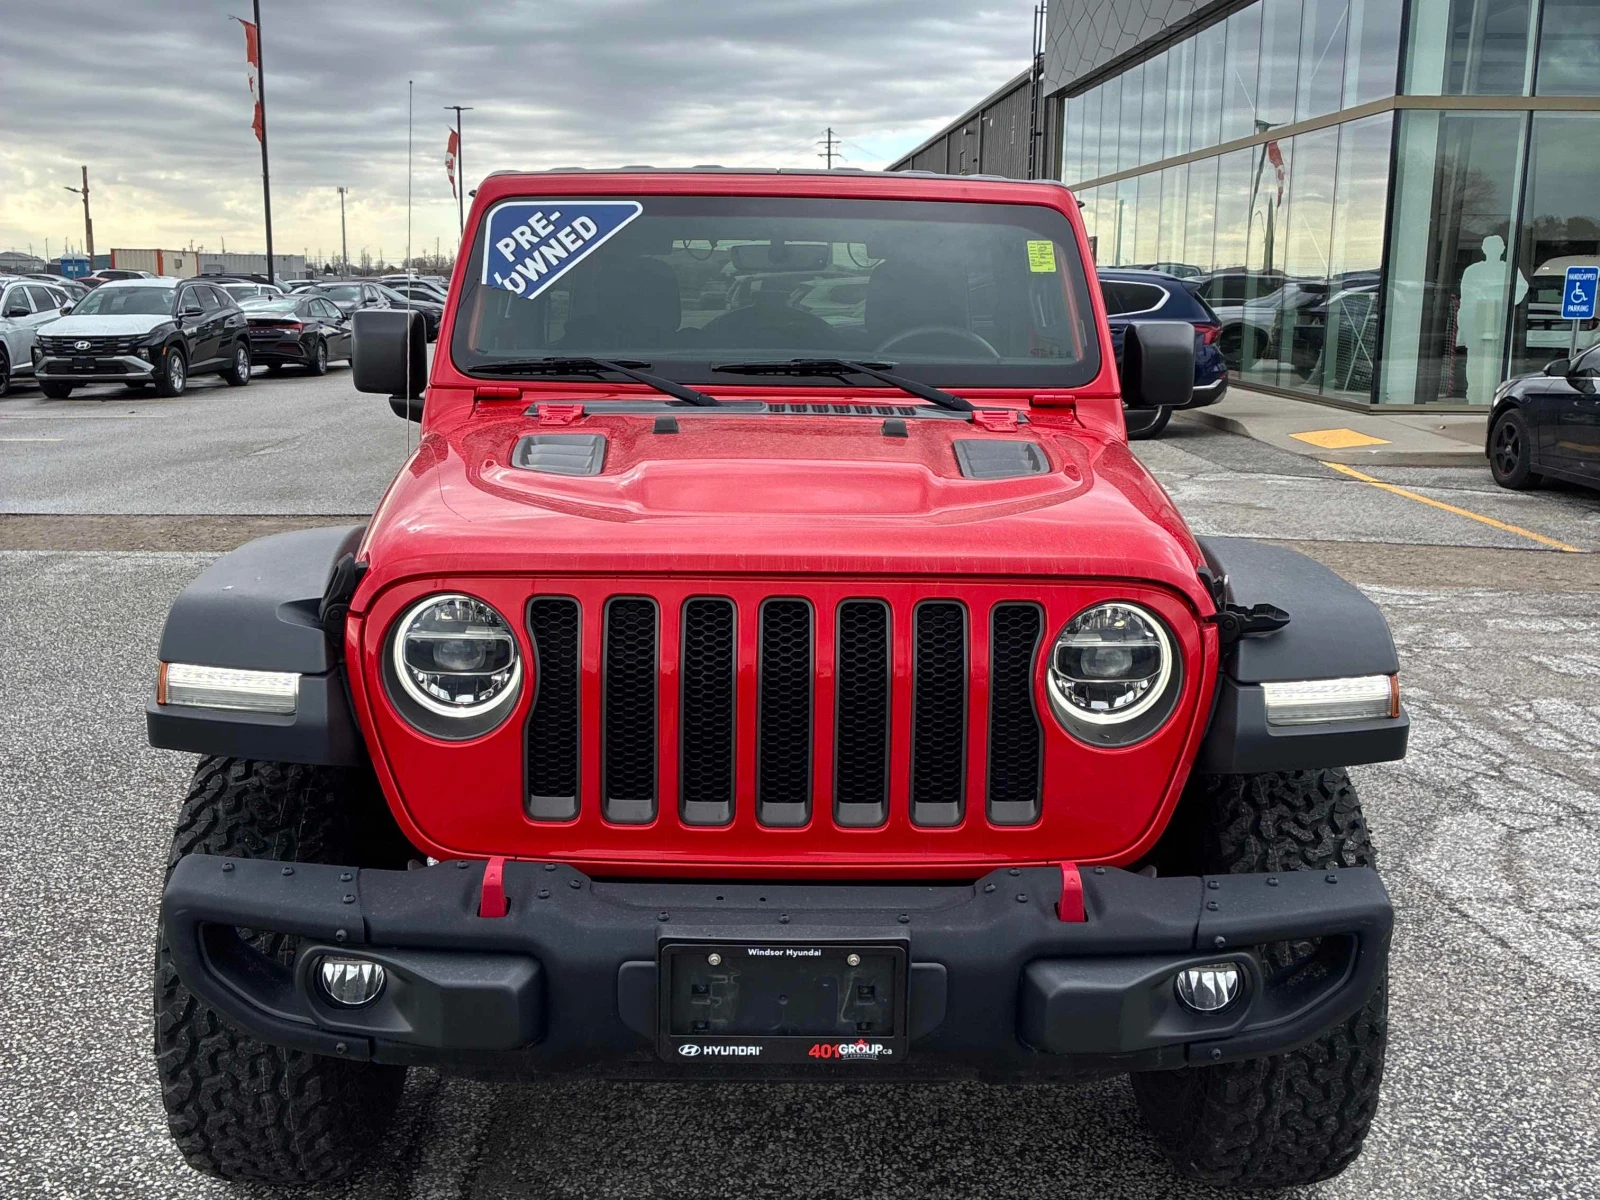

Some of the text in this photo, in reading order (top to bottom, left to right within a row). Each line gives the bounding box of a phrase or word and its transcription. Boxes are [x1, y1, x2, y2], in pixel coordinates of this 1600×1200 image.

[495, 211, 562, 263] PRE-
[494, 215, 598, 295] OWNED
[1567, 304, 1590, 312] PARKING
[747, 948, 822, 958] Windsor Hyundai
[703, 1045, 761, 1056] HYUNDAI
